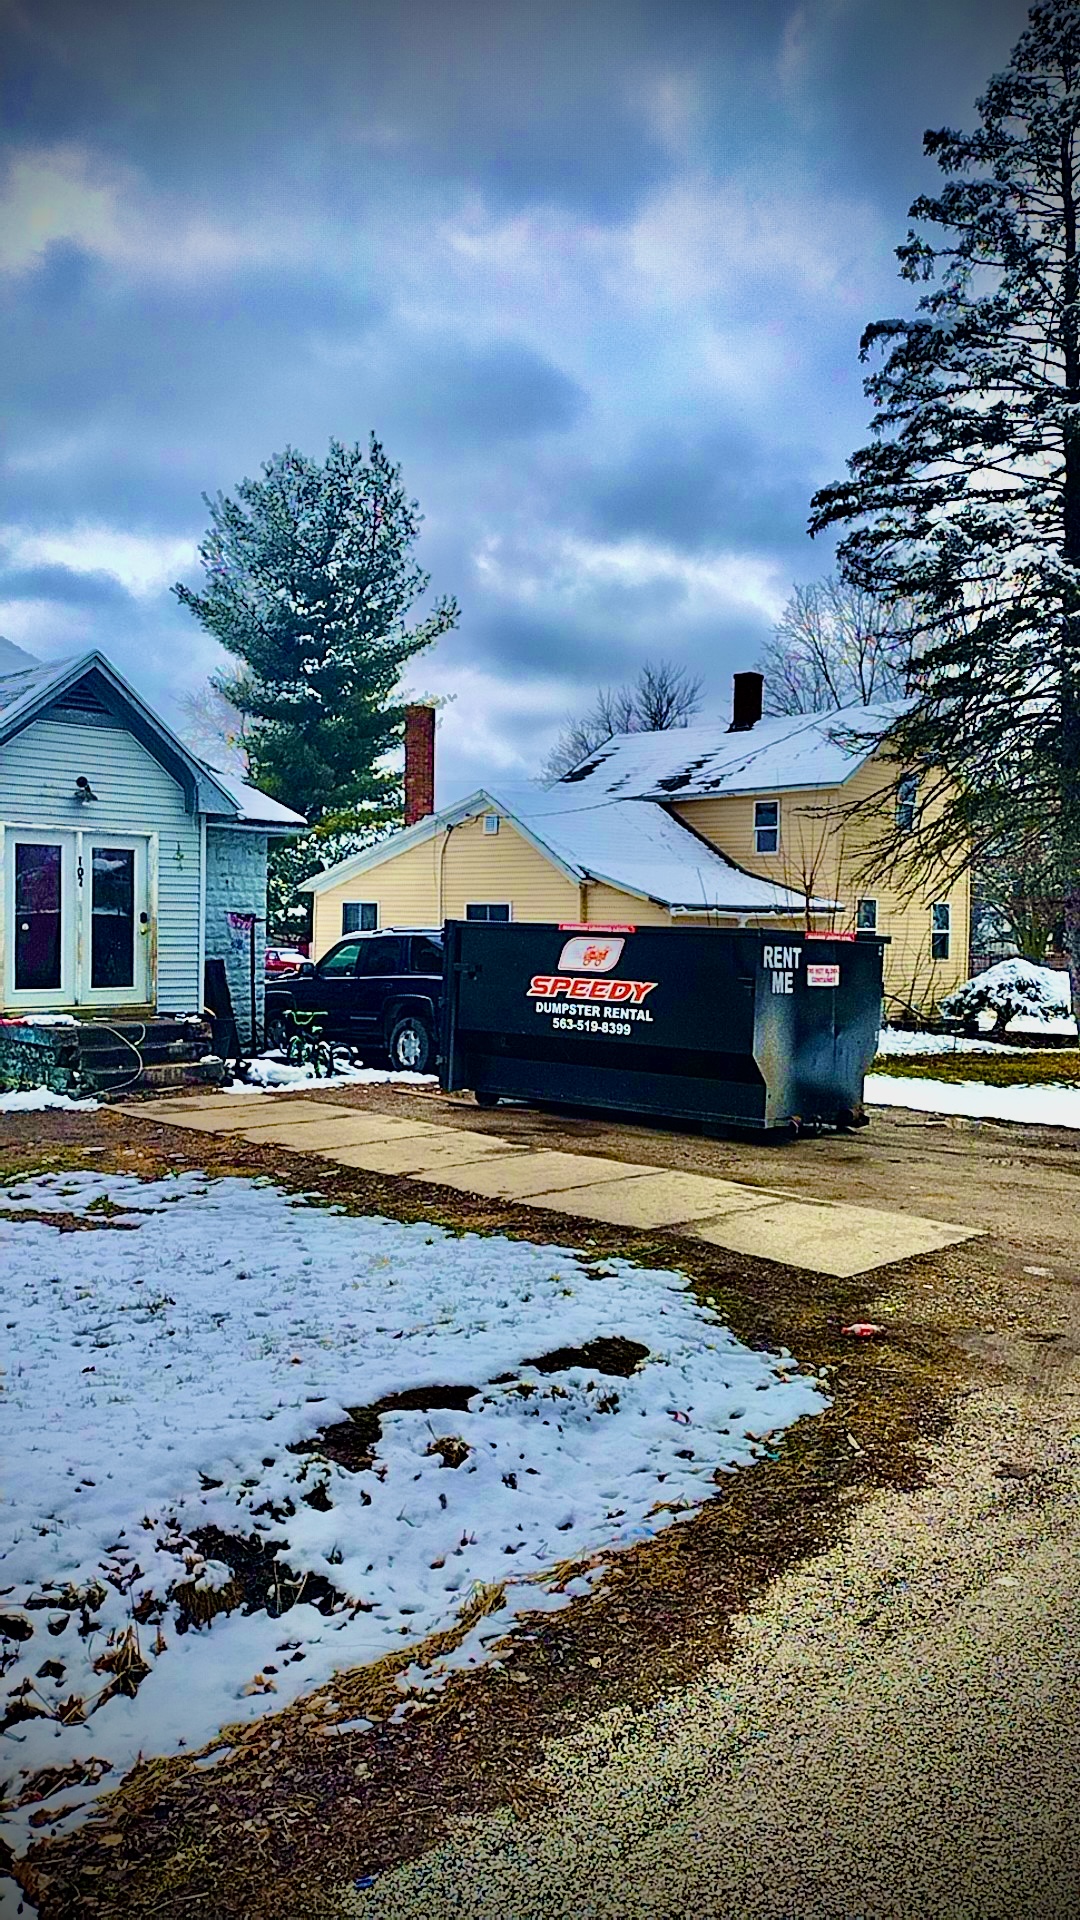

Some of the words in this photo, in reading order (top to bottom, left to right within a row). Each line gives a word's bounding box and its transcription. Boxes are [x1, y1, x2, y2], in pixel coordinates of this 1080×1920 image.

[763, 945, 802, 969] RENT
[526, 975, 659, 1004] SPEEDY
[772, 971, 794, 994] ME
[535, 1001, 600, 1017] DUMPSTER
[603, 1006, 653, 1021] RENTAL
[552, 1018, 631, 1035] 563-519-8399
